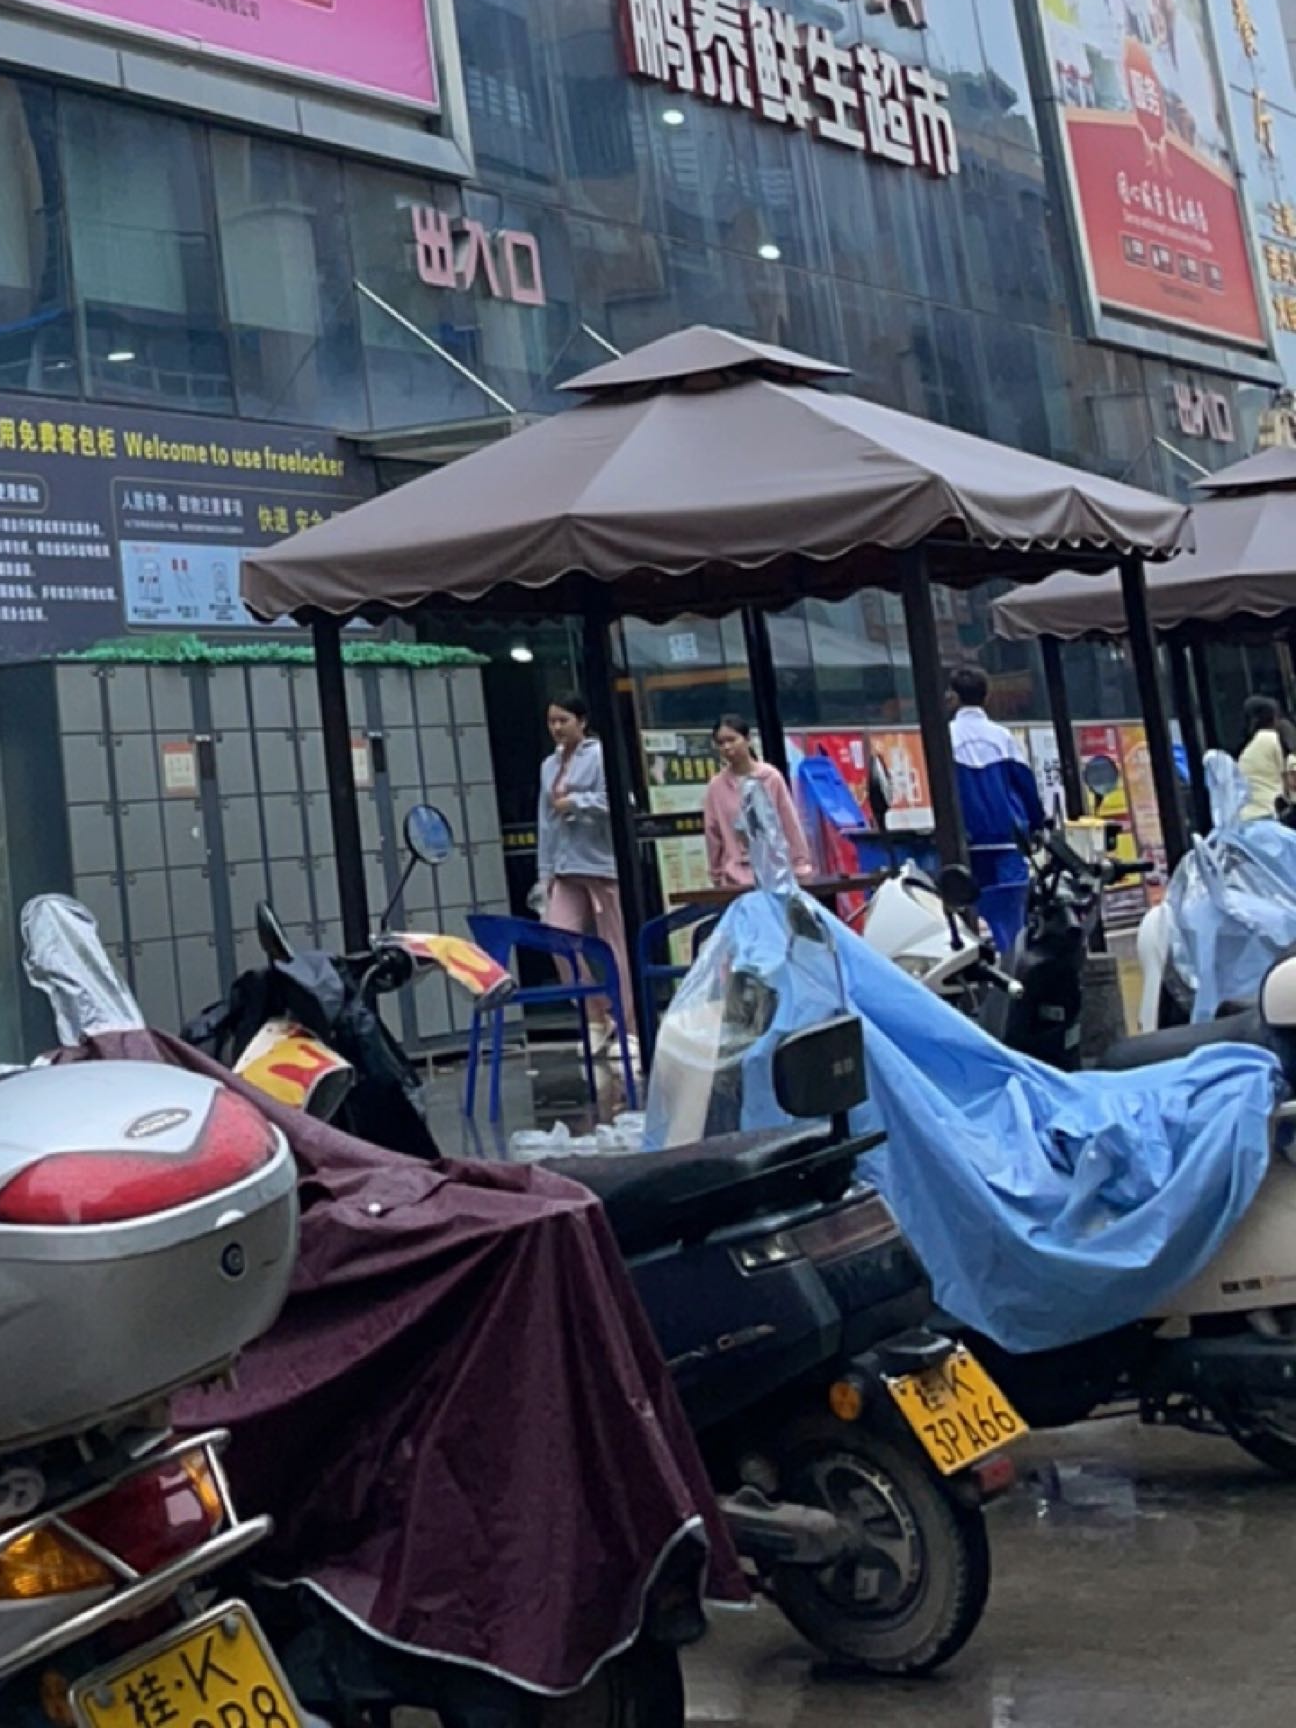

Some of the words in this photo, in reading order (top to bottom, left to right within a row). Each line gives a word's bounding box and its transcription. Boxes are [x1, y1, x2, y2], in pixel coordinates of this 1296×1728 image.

[412, 205, 547, 306] 出入口
[122, 431, 208, 463] Welcome
[210, 442, 230, 465] to
[231, 447, 263, 470] use
[923, 1394, 1017, 1466] 3PA66
